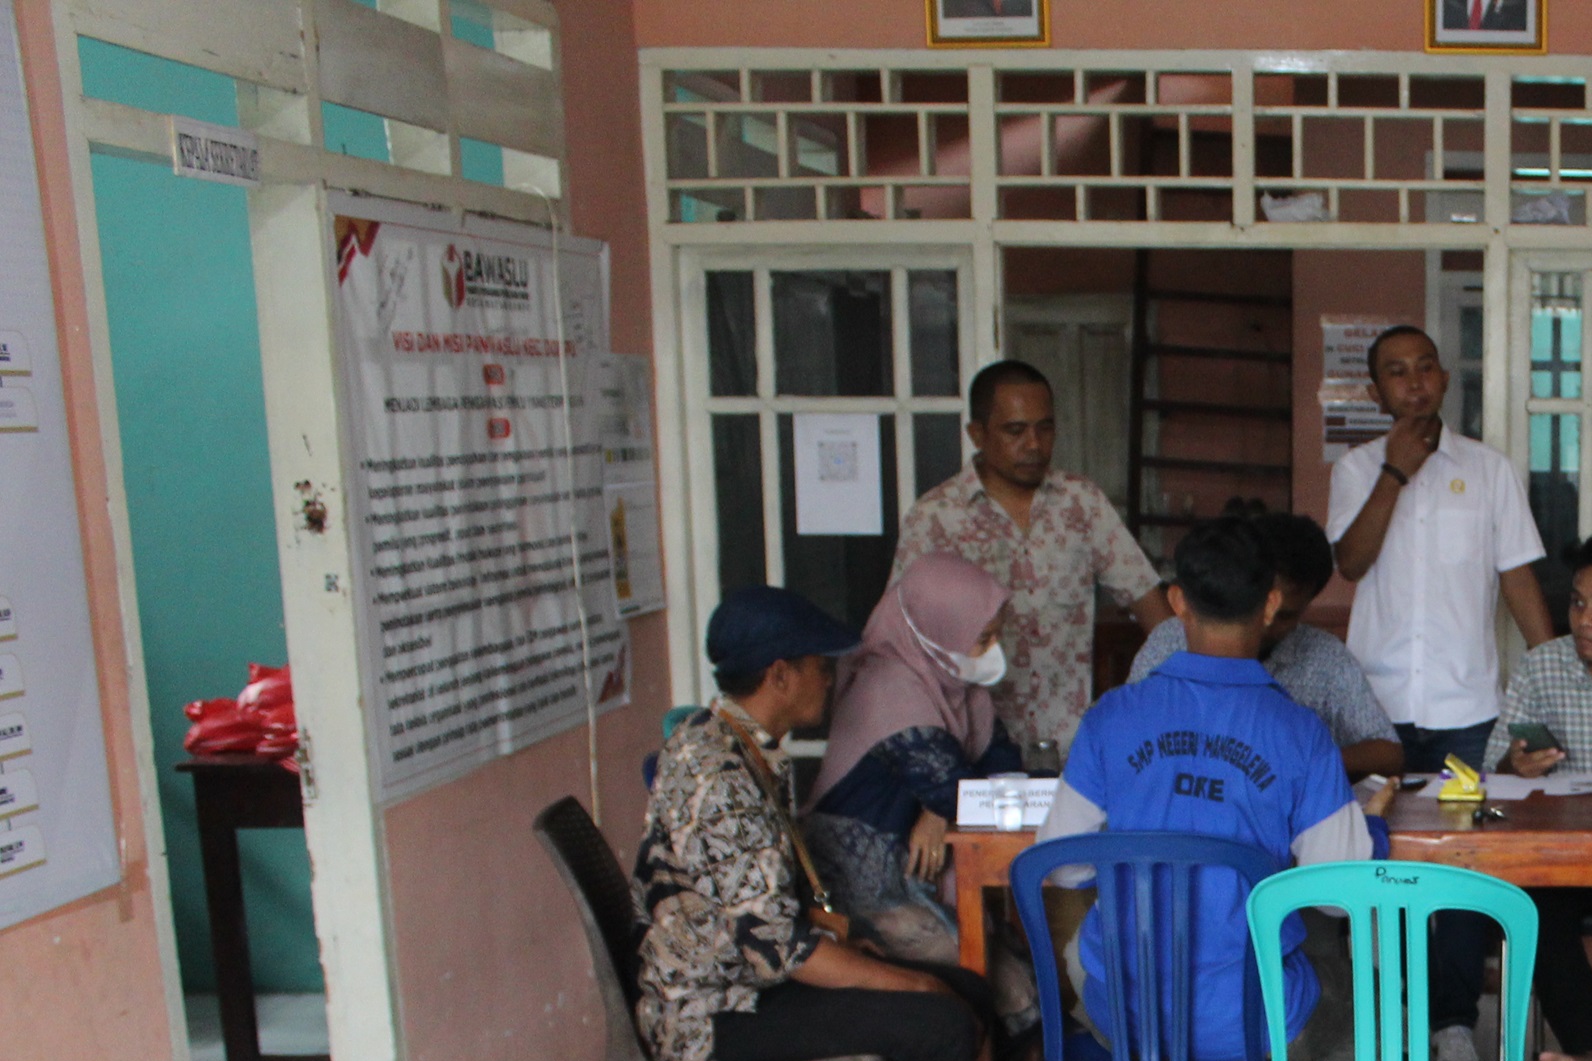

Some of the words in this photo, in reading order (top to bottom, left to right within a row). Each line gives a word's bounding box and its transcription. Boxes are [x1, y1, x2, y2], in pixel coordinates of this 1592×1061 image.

[463, 250, 529, 287] BAWASLU
[1127, 740, 1155, 775] SMP
[1157, 730, 1198, 758] NEGERI
